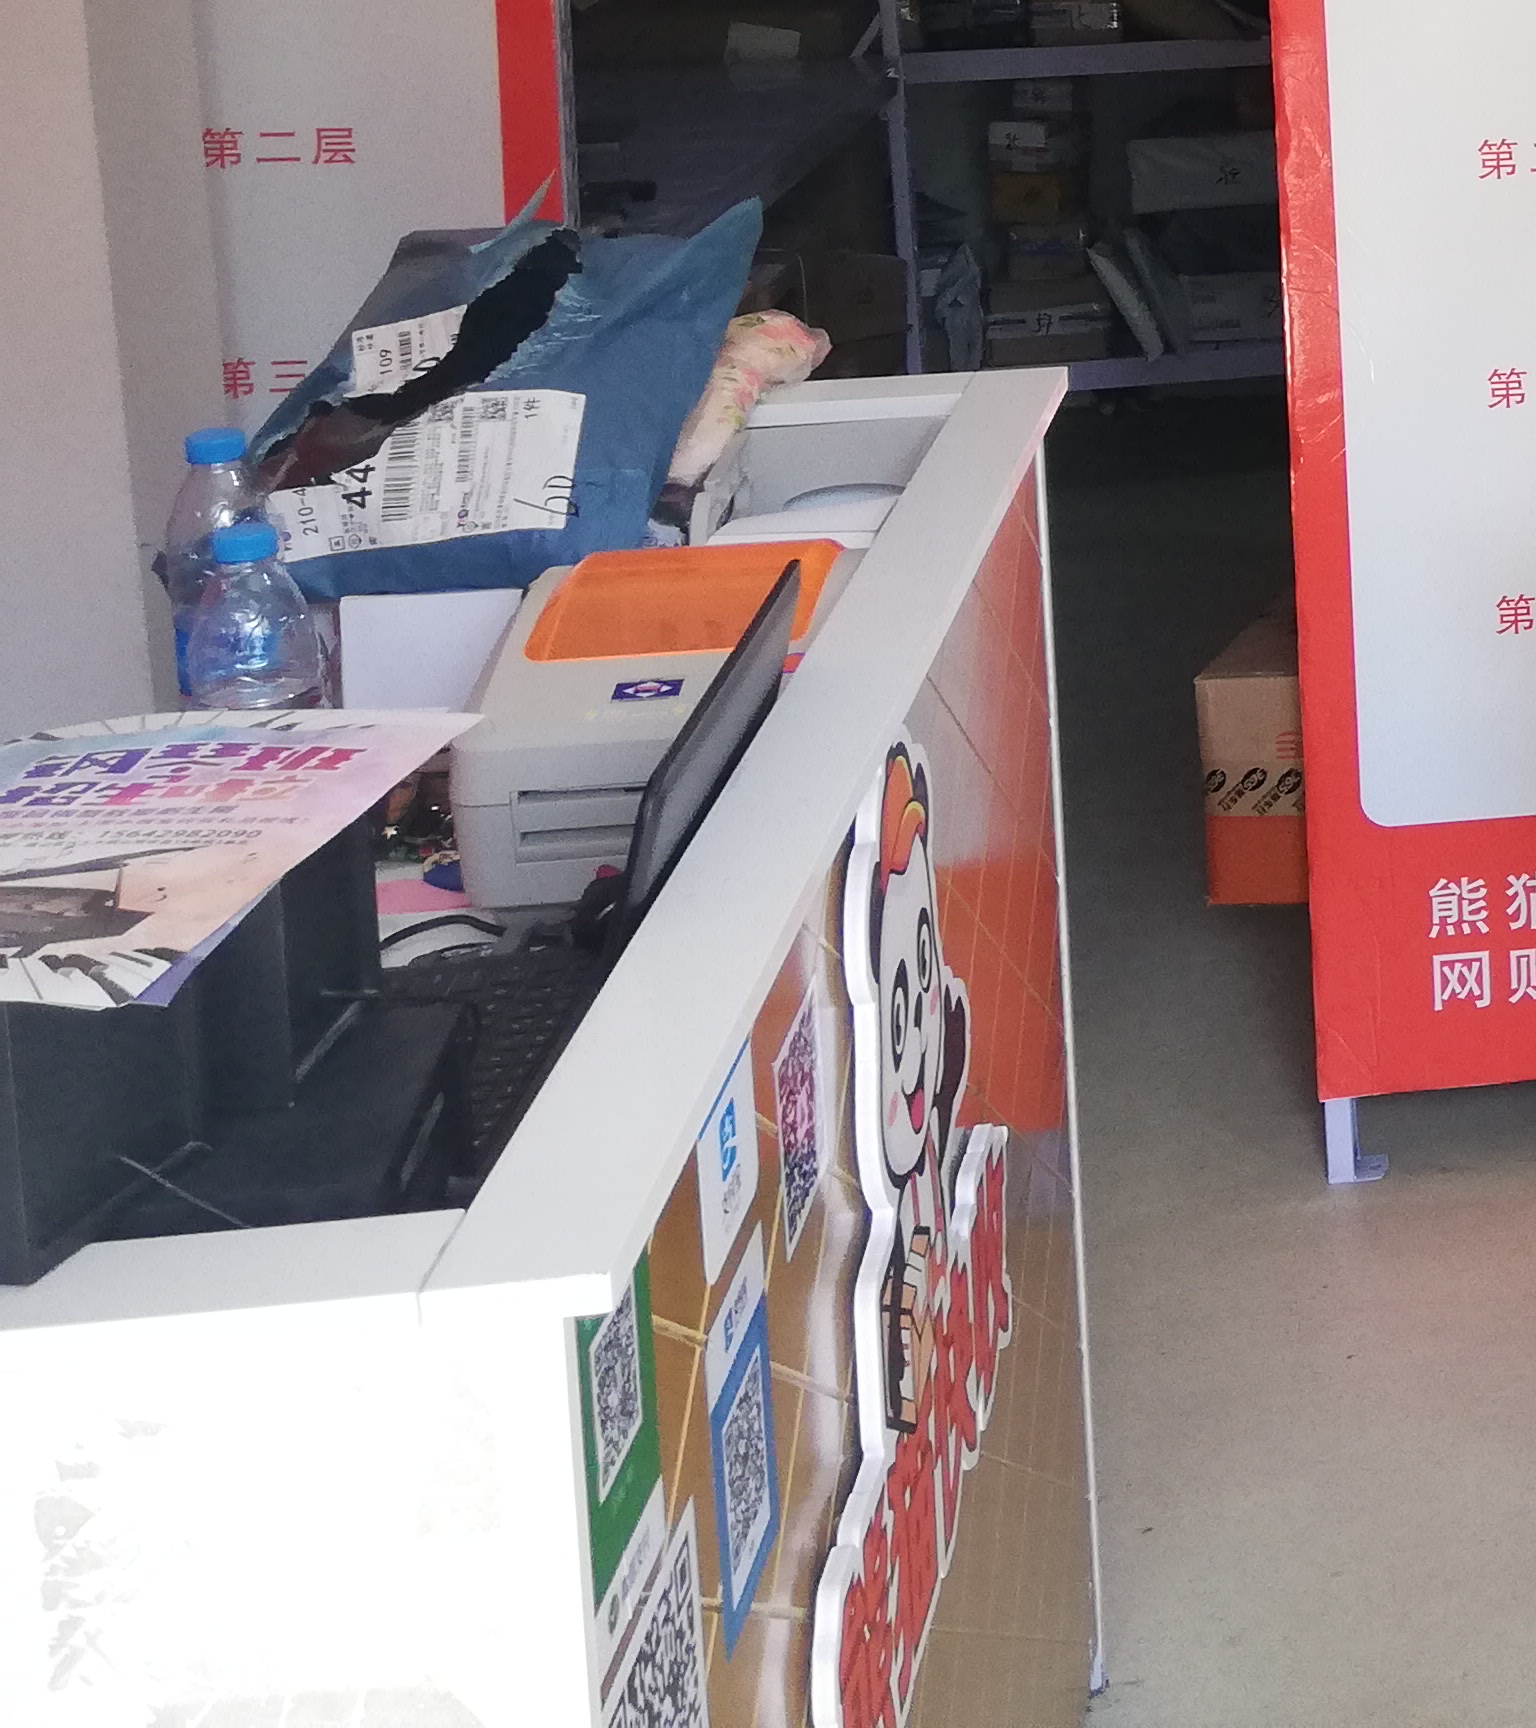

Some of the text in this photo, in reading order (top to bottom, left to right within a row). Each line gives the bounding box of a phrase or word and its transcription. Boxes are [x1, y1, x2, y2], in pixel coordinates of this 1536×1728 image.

[201, 126, 357, 169] 第二层
[341, 463, 375, 510] 44
